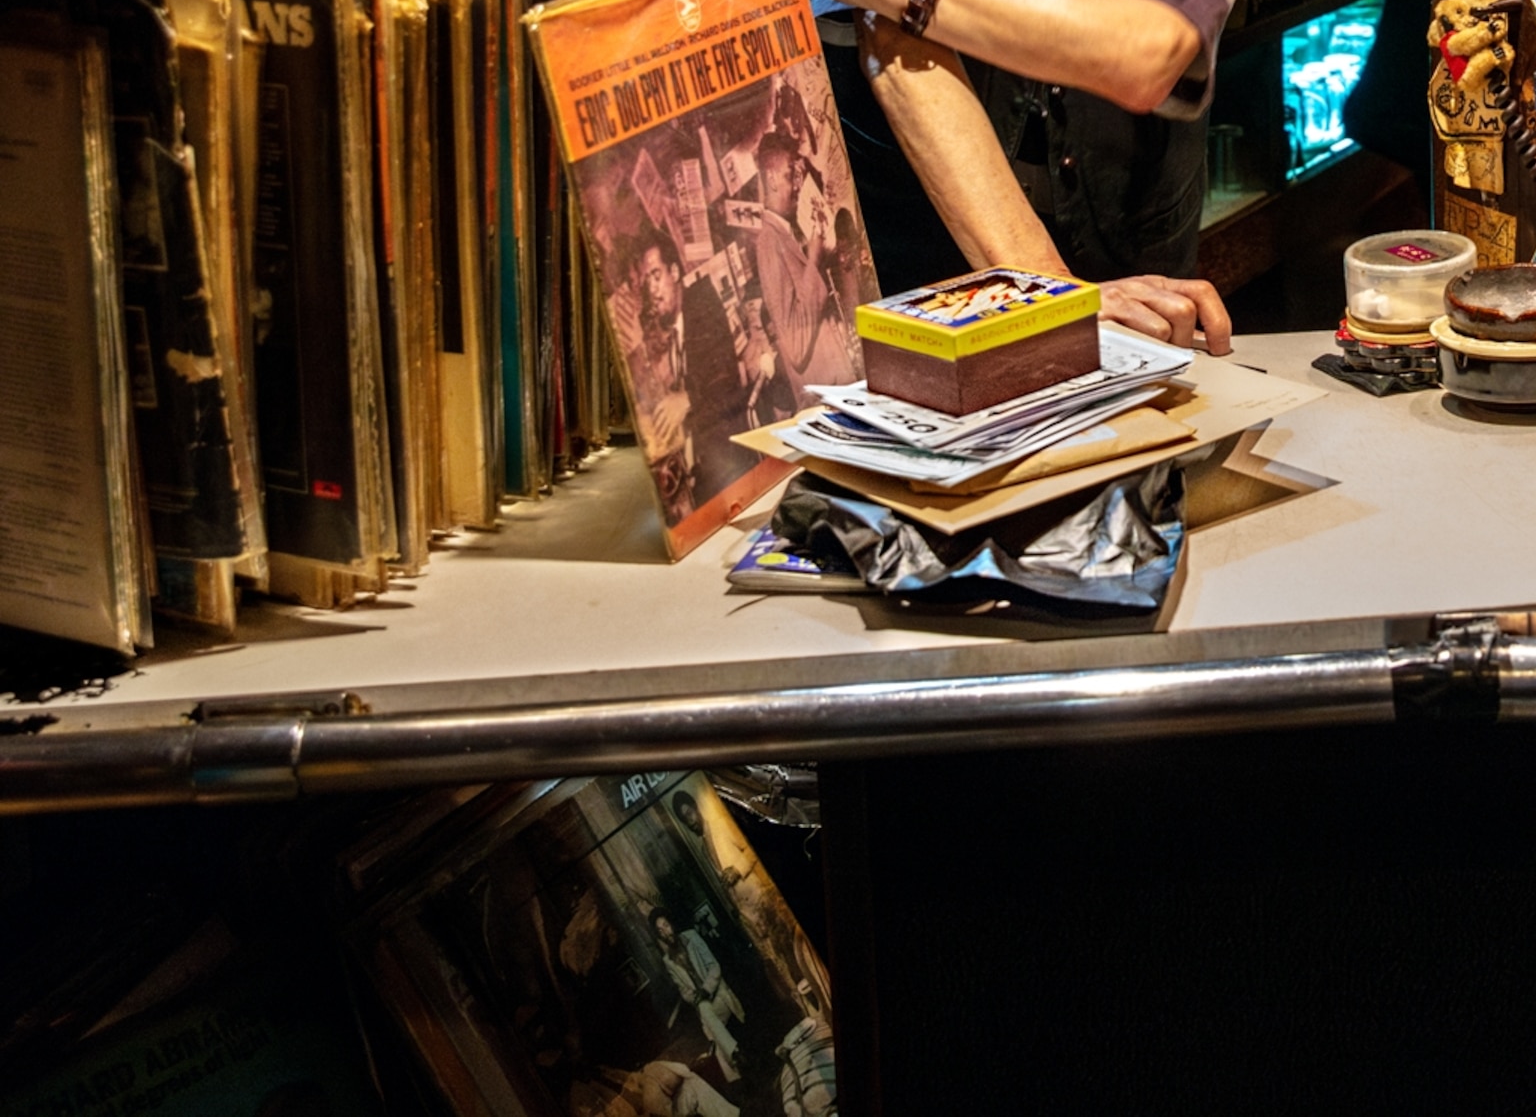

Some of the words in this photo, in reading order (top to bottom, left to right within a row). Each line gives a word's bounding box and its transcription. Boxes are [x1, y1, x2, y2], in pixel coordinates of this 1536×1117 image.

[252, 0, 316, 49] NS
[574, 89, 618, 149] ERIC
[613, 66, 673, 134] DOLPHY
[668, 61, 691, 109] AT
[684, 49, 717, 102] THE
[712, 36, 747, 89] FIVE
[741, 22, 781, 76] SPOT,
[797, 9, 813, 52] 1
[603, 60, 631, 81] LITTLE
[620, 773, 649, 809] AIR
